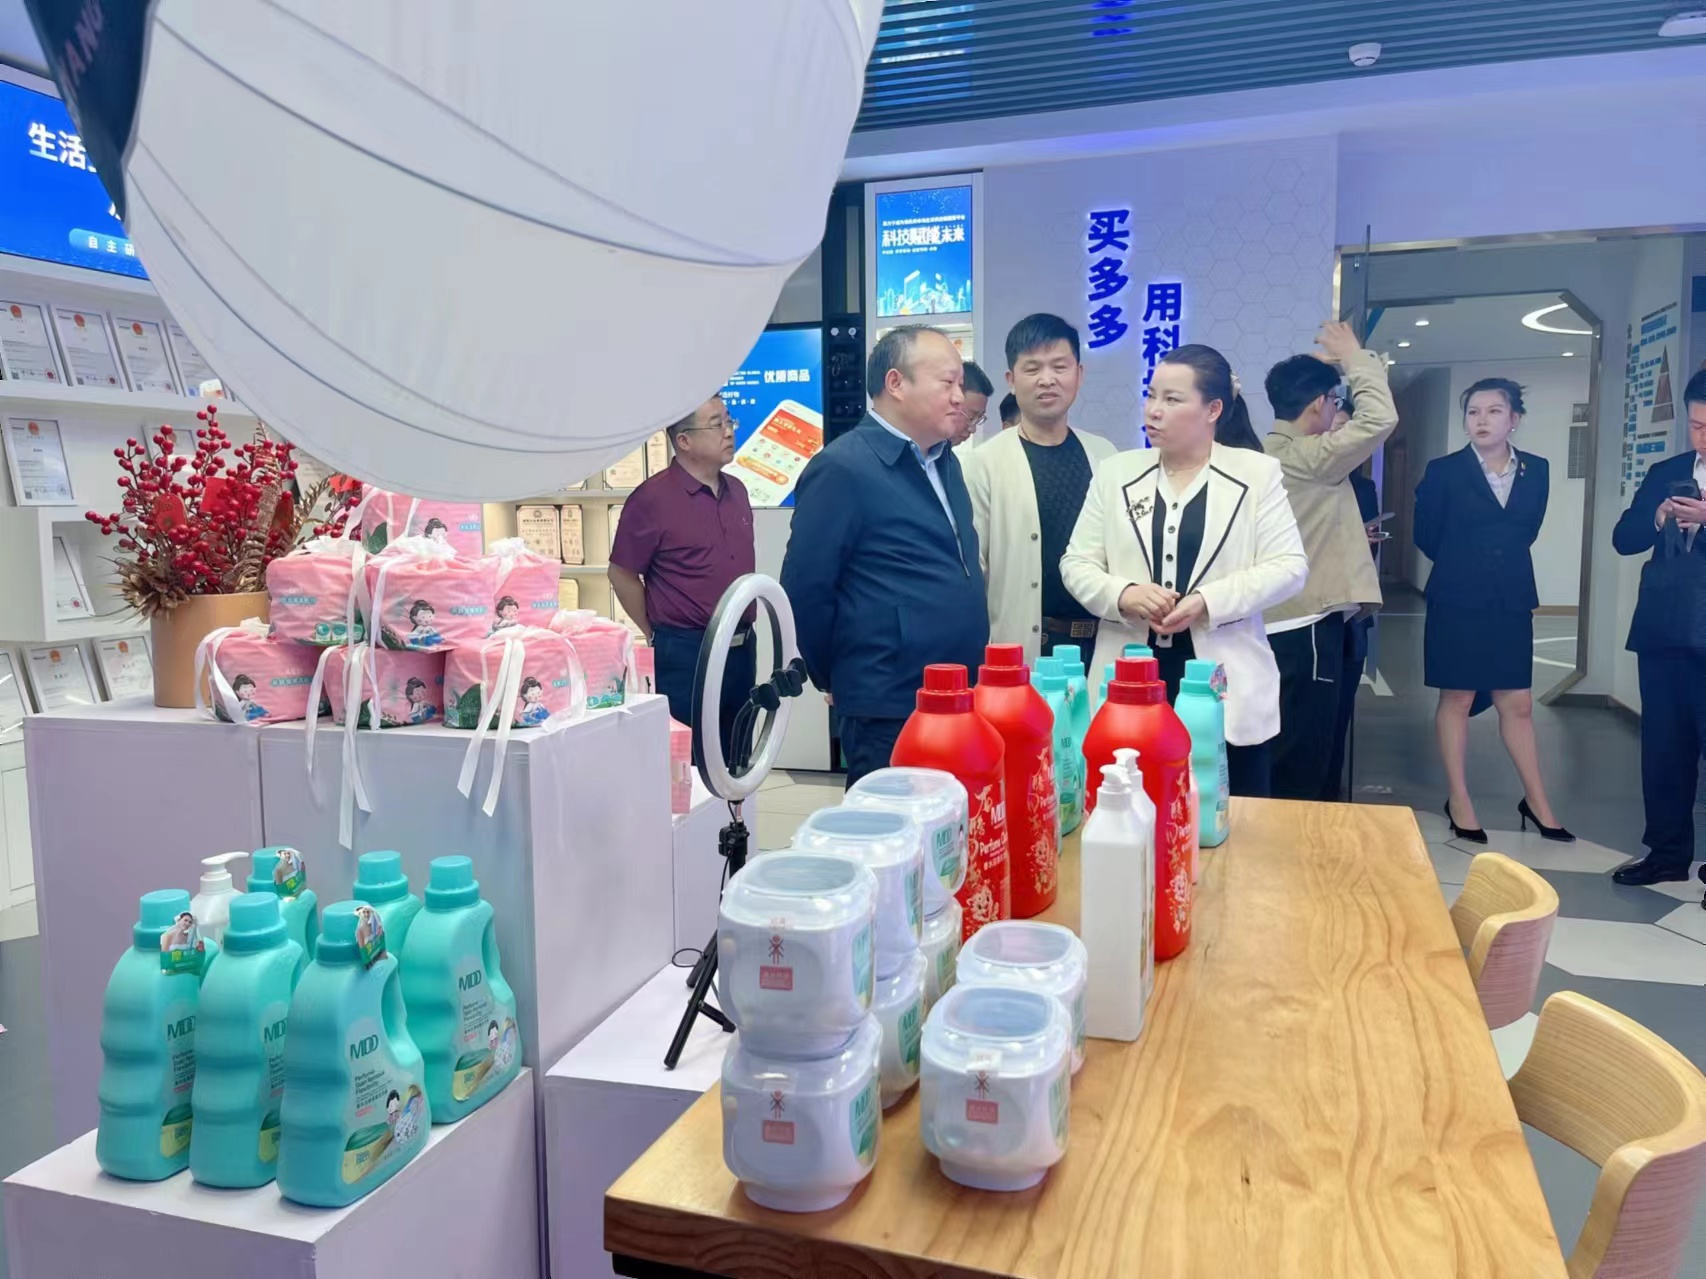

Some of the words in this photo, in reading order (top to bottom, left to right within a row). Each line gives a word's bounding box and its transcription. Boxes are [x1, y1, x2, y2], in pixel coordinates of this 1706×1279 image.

[28, 122, 97, 173] 生活
[1088, 209, 1130, 348] 买多多
[458, 969, 482, 991] MDD
[264, 1017, 288, 1042] MD
[349, 1034, 379, 1059] MDD
